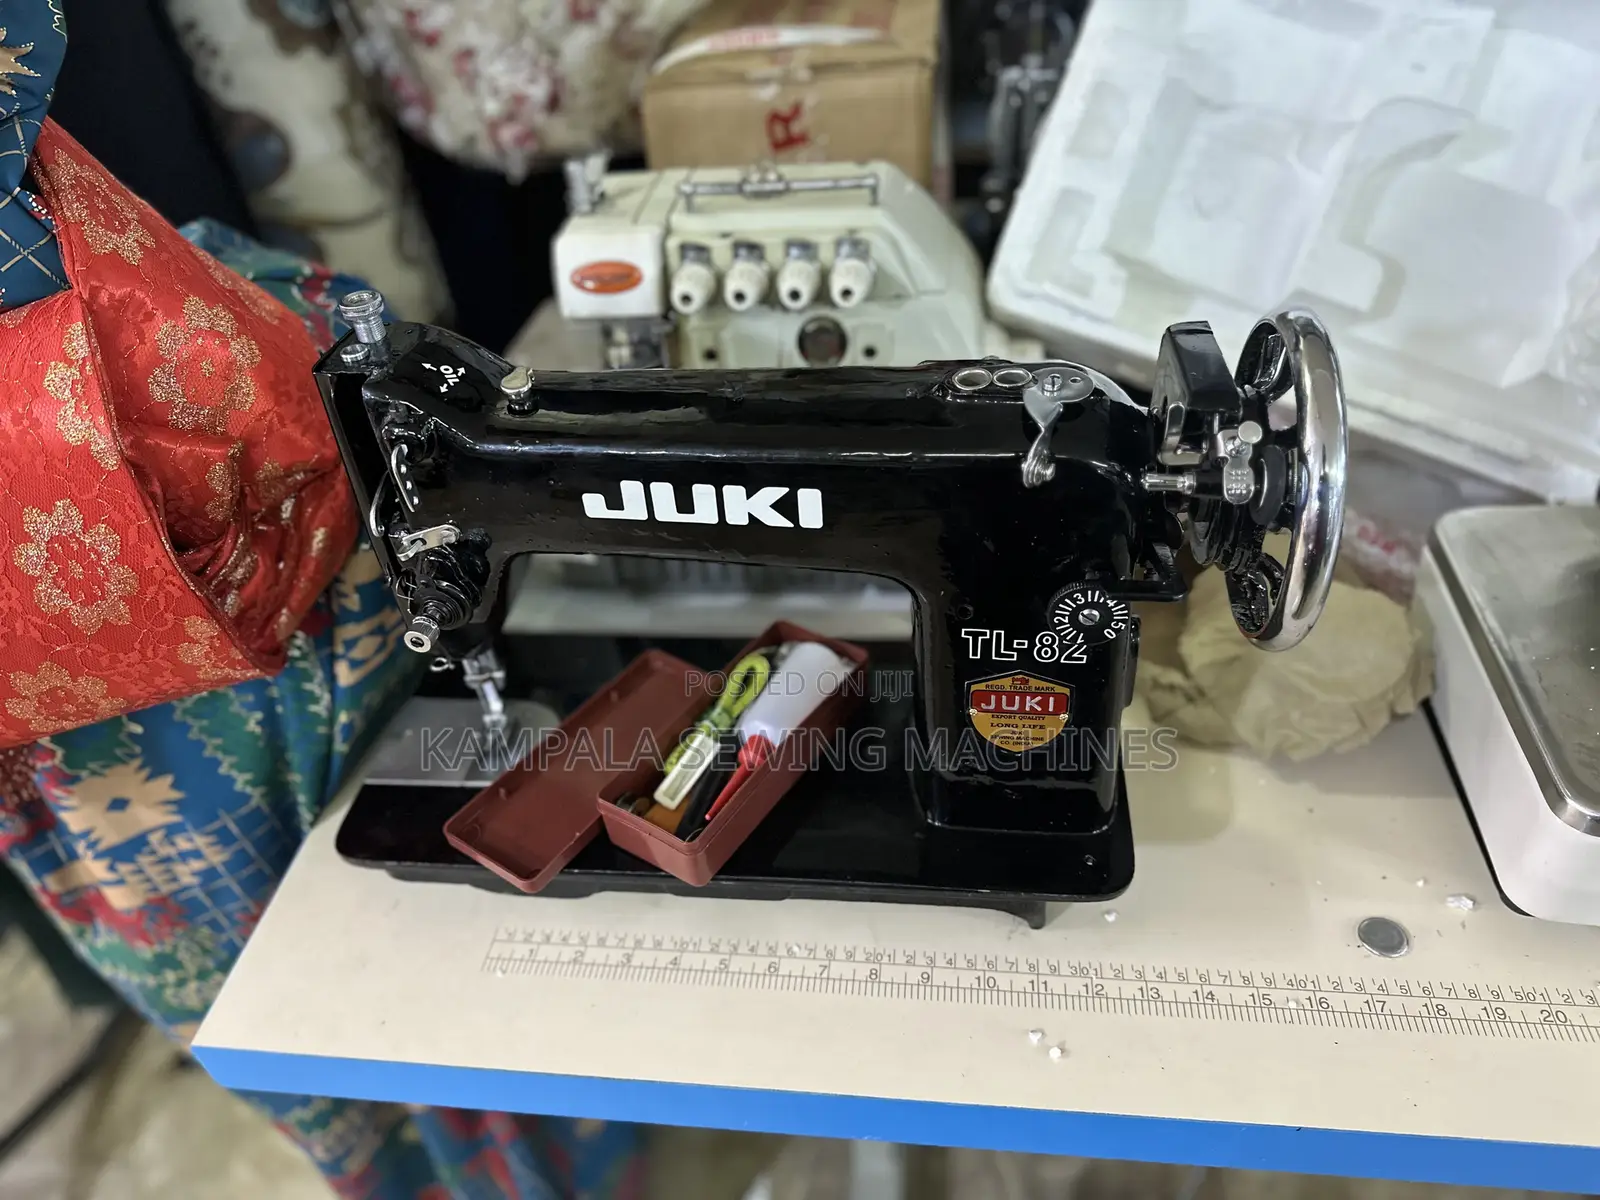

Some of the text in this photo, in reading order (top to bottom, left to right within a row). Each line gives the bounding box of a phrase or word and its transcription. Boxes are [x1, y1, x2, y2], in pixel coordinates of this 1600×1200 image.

[440, 365, 460, 386] OIL
[581, 480, 824, 529] JUKI
[1073, 593, 1085, 604] 3
[1053, 616, 1069, 624] 2
[1111, 621, 1126, 630] 5
[1103, 629, 1116, 639] 0
[980, 694, 1055, 712] JUKI
[826, 949, 833, 958] 8
[845, 950, 853, 960] 9
[905, 955, 913, 964] 2
[925, 956, 933, 965] 3
[946, 957, 953, 966] 4
[966, 958, 974, 968] 5
[987, 960, 995, 969] 6
[1007, 961, 1015, 970] 7
[1027, 962, 1036, 972] 8
[1049, 963, 1057, 973] 9
[1113, 968, 1121, 978] 2
[1134, 969, 1143, 979] 3
[1156, 971, 1164, 980] 4
[1178, 972, 1185, 982] 5
[1199, 973, 1207, 983] 6
[1219, 974, 1228, 984] 7
[1242, 975, 1251, 985] 8
[1264, 976, 1272, 986] 9
[1332, 981, 1340, 991] 2
[1354, 982, 1363, 992] 3
[1377, 984, 1385, 993] 4
[1400, 985, 1408, 994] 5
[1422, 986, 1431, 996] 6
[1444, 987, 1452, 997] 7
[1468, 989, 1477, 999] 8
[1491, 990, 1500, 1000] 9
[1562, 993, 1572, 1004] 2
[1585, 995, 1596, 1005] 3
[574, 950, 584, 963] 2
[621, 952, 631, 965] 3
[669, 956, 678, 968] 4
[719, 958, 728, 971] 5
[768, 961, 778, 974] 6
[819, 964, 828, 976] 7
[869, 968, 878, 980] 8
[921, 971, 930, 984] 9
[975, 975, 997, 989] 10
[1028, 979, 1049, 993] 11
[1083, 983, 1105, 996] 12
[1137, 986, 1161, 1000] 13
[1192, 990, 1215, 1003] 14
[1249, 993, 1273, 1006] 15
[1305, 996, 1330, 1010] 16
[1363, 999, 1387, 1013] 17
[1422, 1003, 1447, 1017] 18
[1481, 1006, 1507, 1020] 19
[1540, 1009, 1568, 1023] 20
